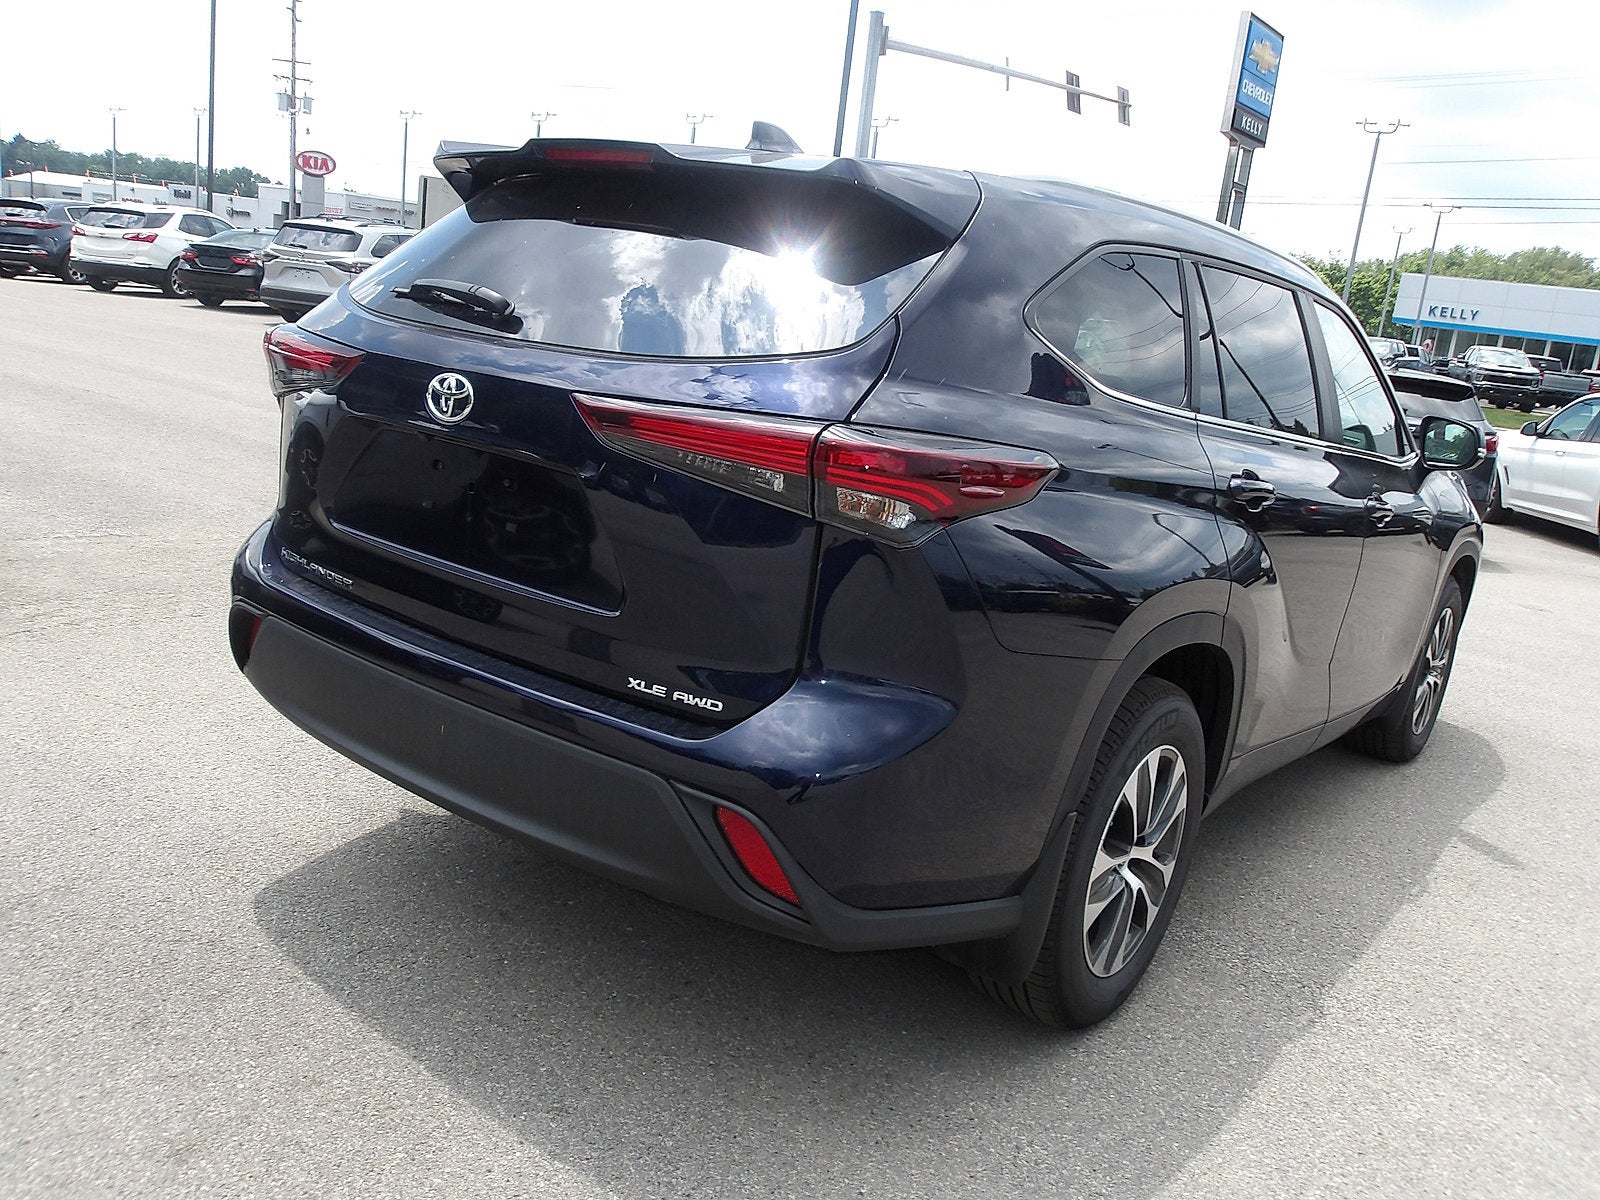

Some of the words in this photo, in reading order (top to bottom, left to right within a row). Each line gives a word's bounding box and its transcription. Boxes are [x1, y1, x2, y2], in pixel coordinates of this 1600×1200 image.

[1242, 79, 1273, 106] CHEVROLET
[1241, 115, 1263, 136] KELLY
[302, 154, 330, 172] KIA
[1428, 305, 1479, 320] KELLY
[627, 676, 668, 698] XLE
[672, 691, 724, 712] AWD
